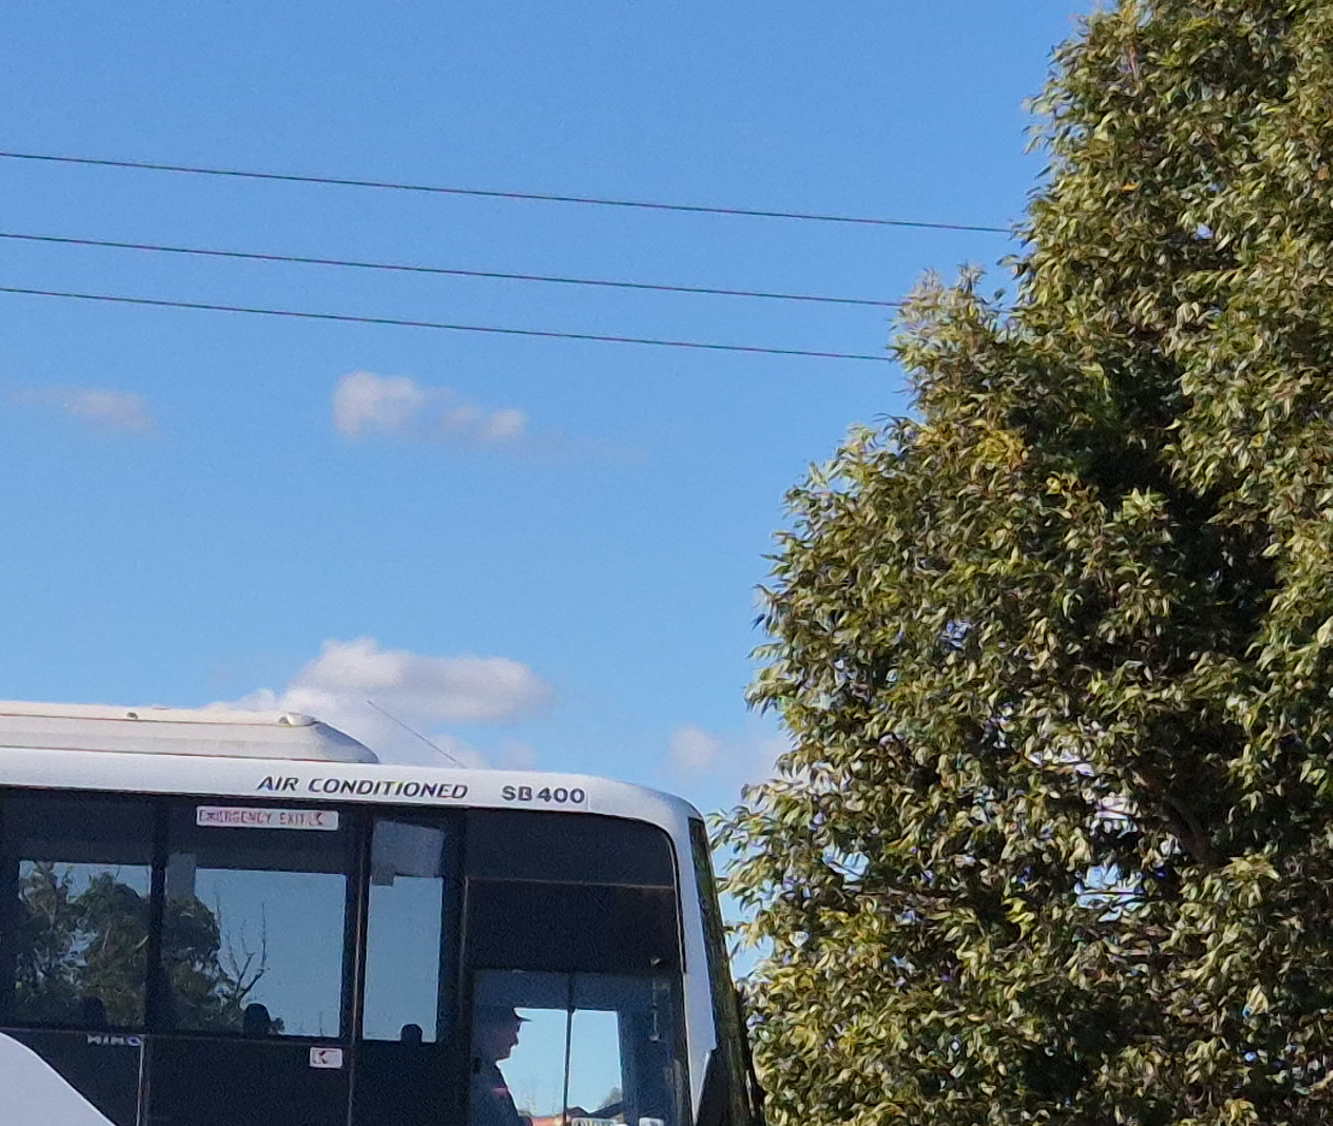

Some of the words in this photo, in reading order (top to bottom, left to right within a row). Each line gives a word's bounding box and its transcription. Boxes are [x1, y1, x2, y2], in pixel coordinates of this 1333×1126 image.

[256, 775, 299, 792] AIR
[307, 777, 469, 799] CONDITIONED
[199, 809, 272, 824] EMERGENCY
